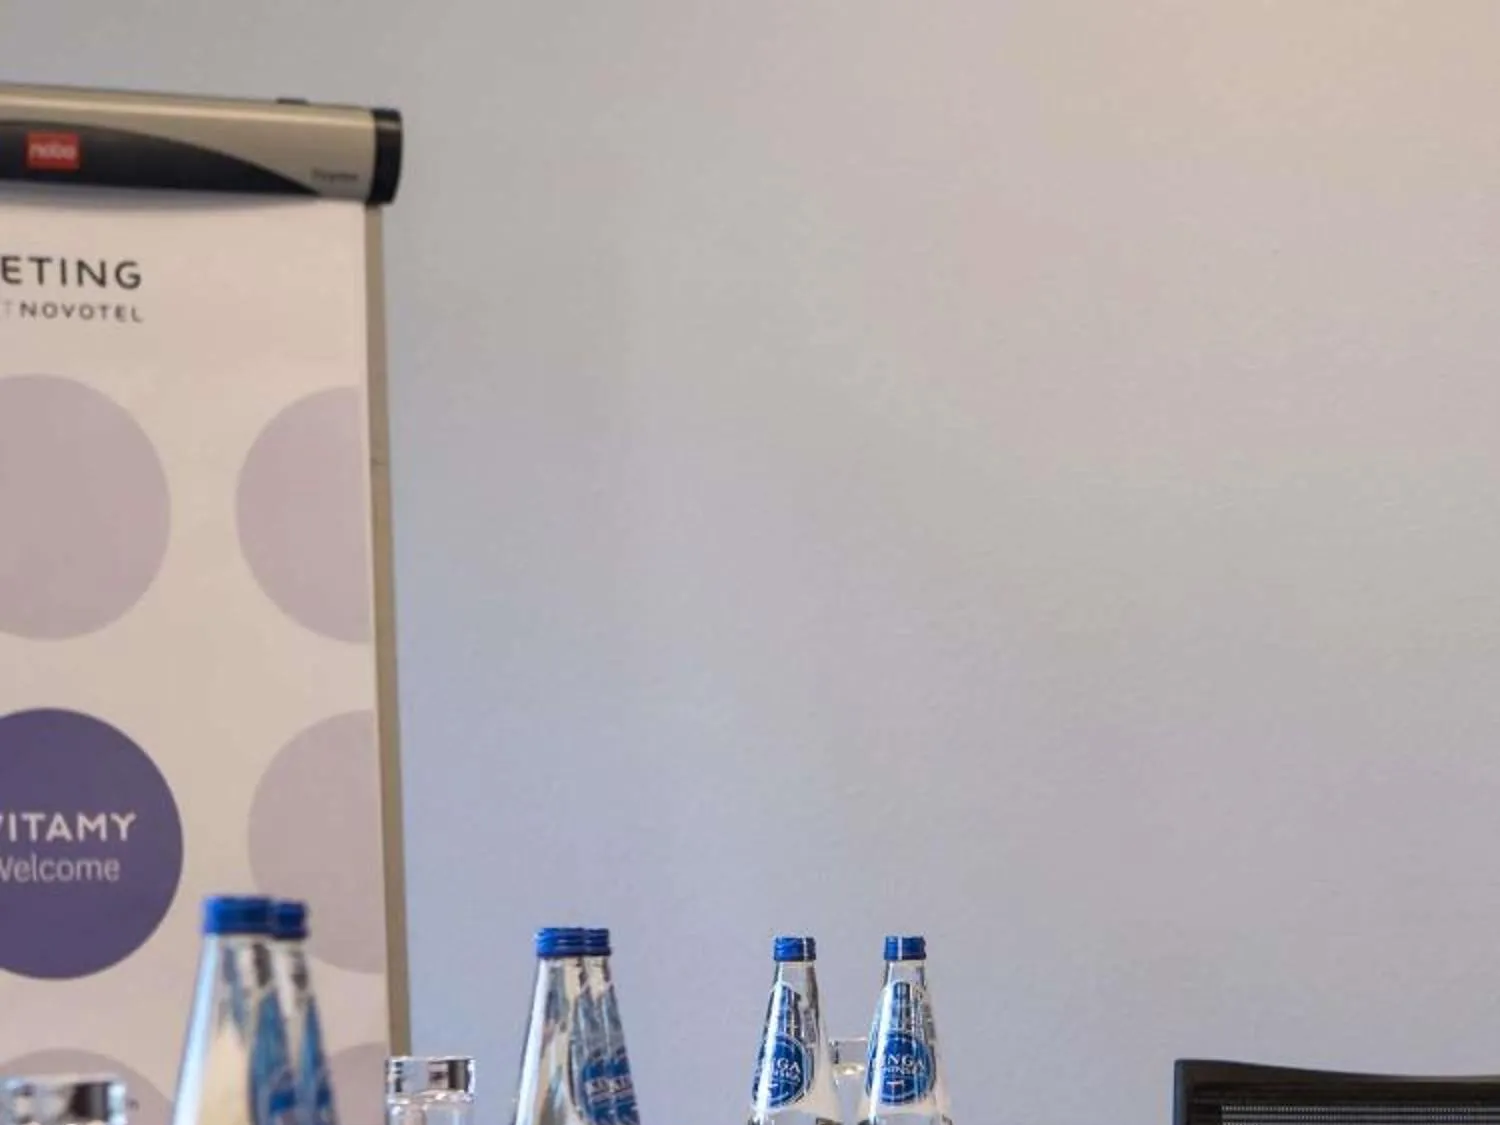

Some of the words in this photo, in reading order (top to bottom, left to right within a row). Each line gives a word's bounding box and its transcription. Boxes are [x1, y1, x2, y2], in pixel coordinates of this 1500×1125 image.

[0, 255, 142, 290] ETING
[19, 300, 144, 323] NOVOTEL
[0, 811, 137, 842] ITAMY
